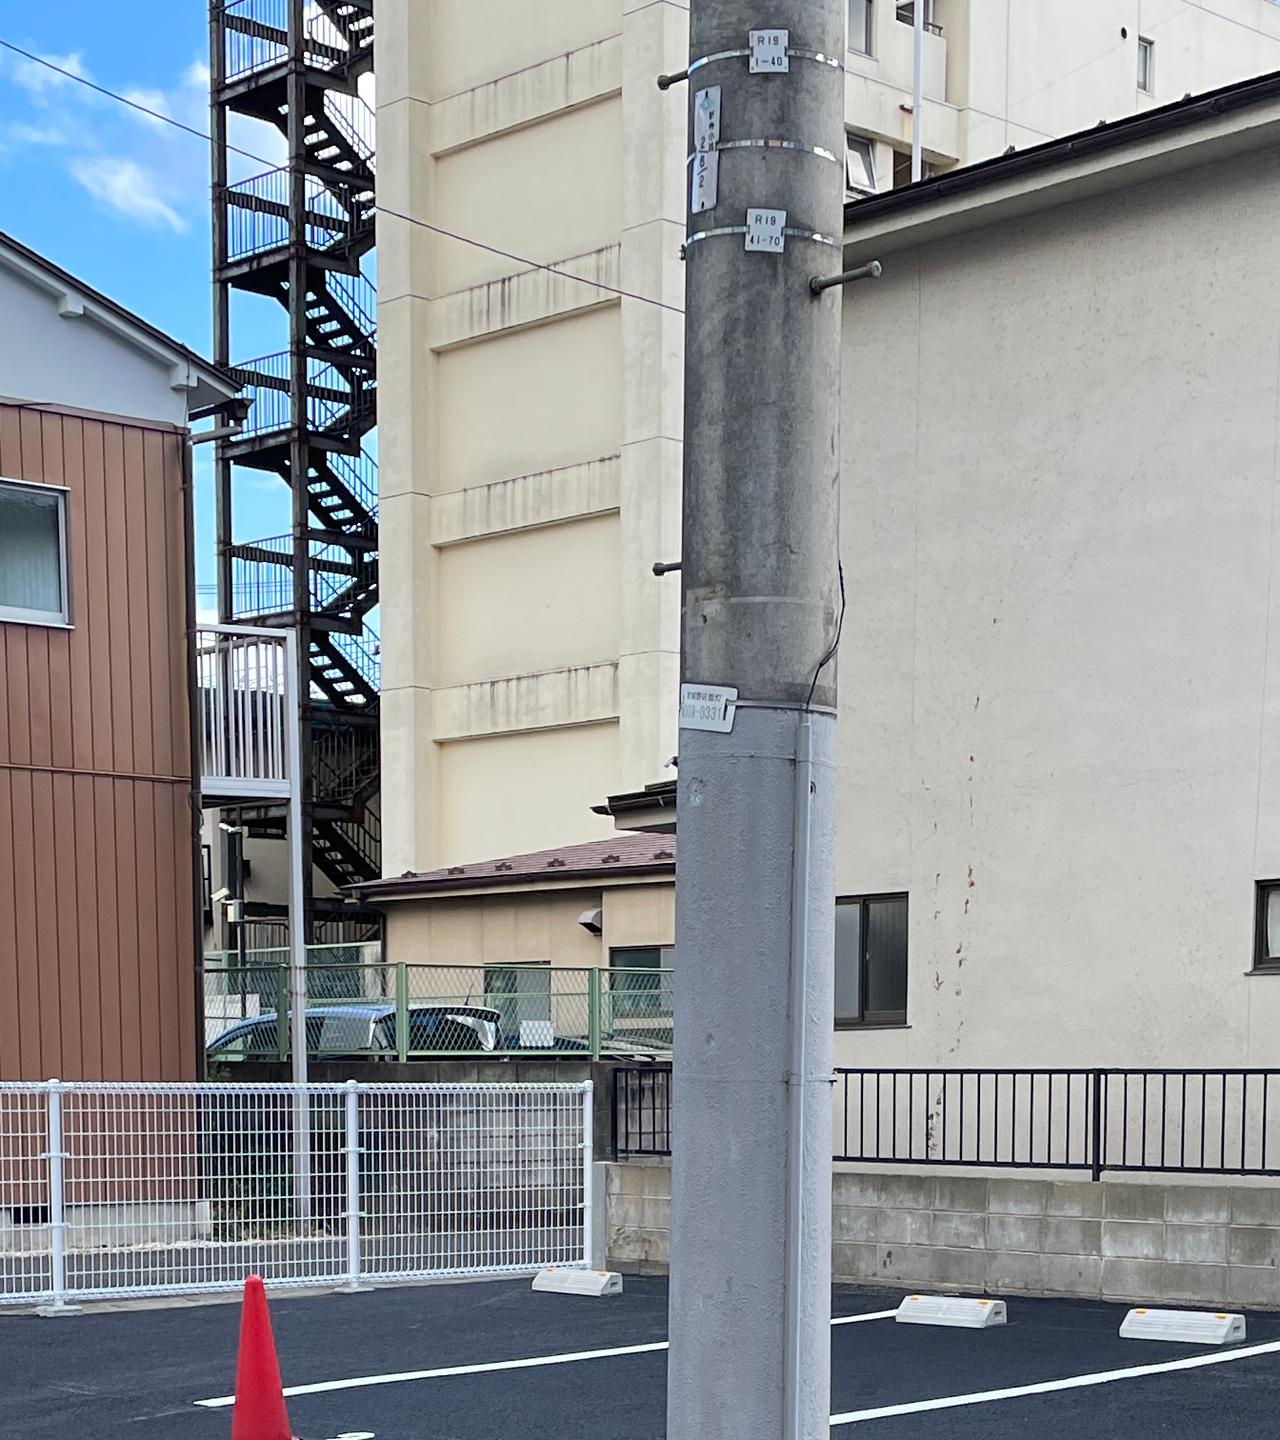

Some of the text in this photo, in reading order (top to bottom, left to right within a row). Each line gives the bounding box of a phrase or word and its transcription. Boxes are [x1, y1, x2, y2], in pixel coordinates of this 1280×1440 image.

[757, 35, 779, 46] R19
[755, 214, 777, 226] R19
[749, 235, 781, 246] 41-70
